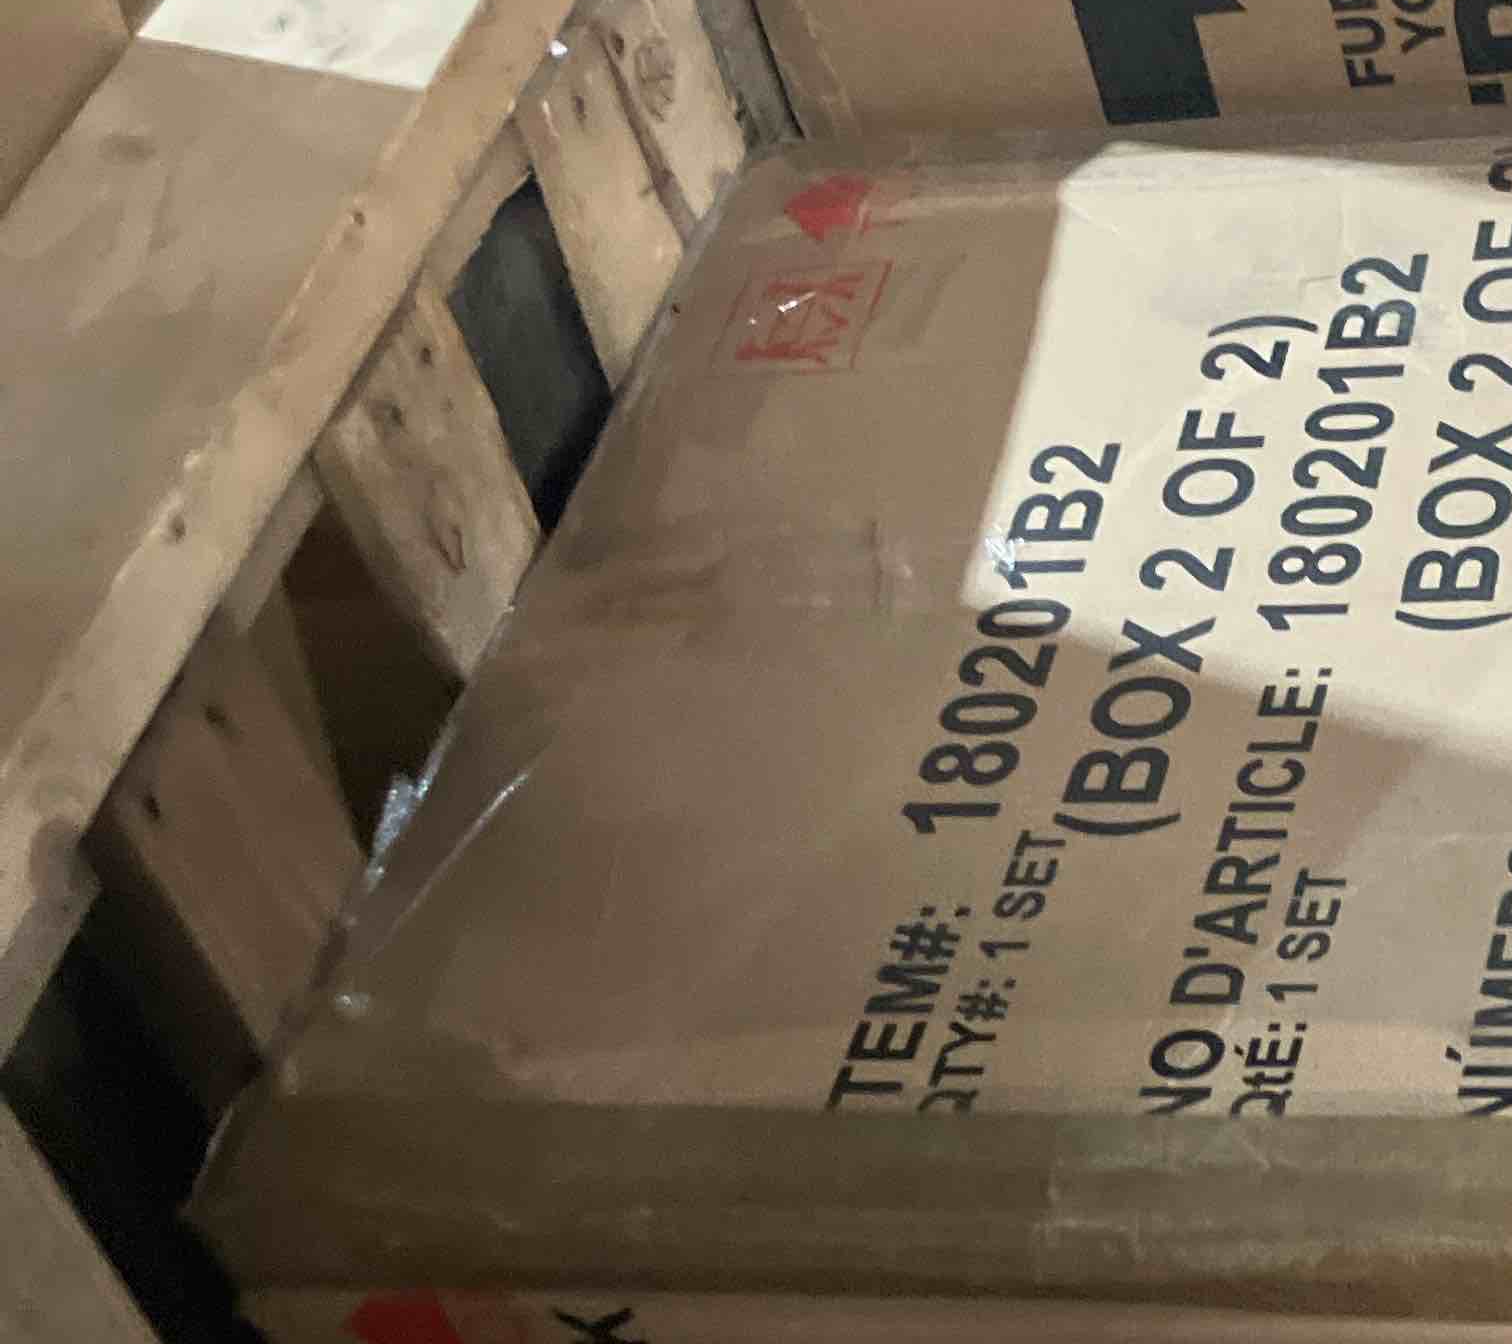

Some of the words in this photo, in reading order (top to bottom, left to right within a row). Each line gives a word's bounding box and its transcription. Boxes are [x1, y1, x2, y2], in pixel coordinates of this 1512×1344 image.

[1200, 315, 1319, 380] 2)
[1162, 409, 1266, 517] OF
[1139, 547, 1236, 592] 2
[1169, 667, 1333, 1006] D'ARTICLE:
[1257, 253, 1429, 630] 180201B2
[1053, 617, 1216, 836] (BOX
[825, 905, 970, 1111] TEM#:
[903, 442, 1121, 835] 180201B2
[993, 829, 1067, 921] SET
[1276, 867, 1347, 962] SET
[978, 938, 1031, 961] 1
[1265, 981, 1319, 1003] 1
